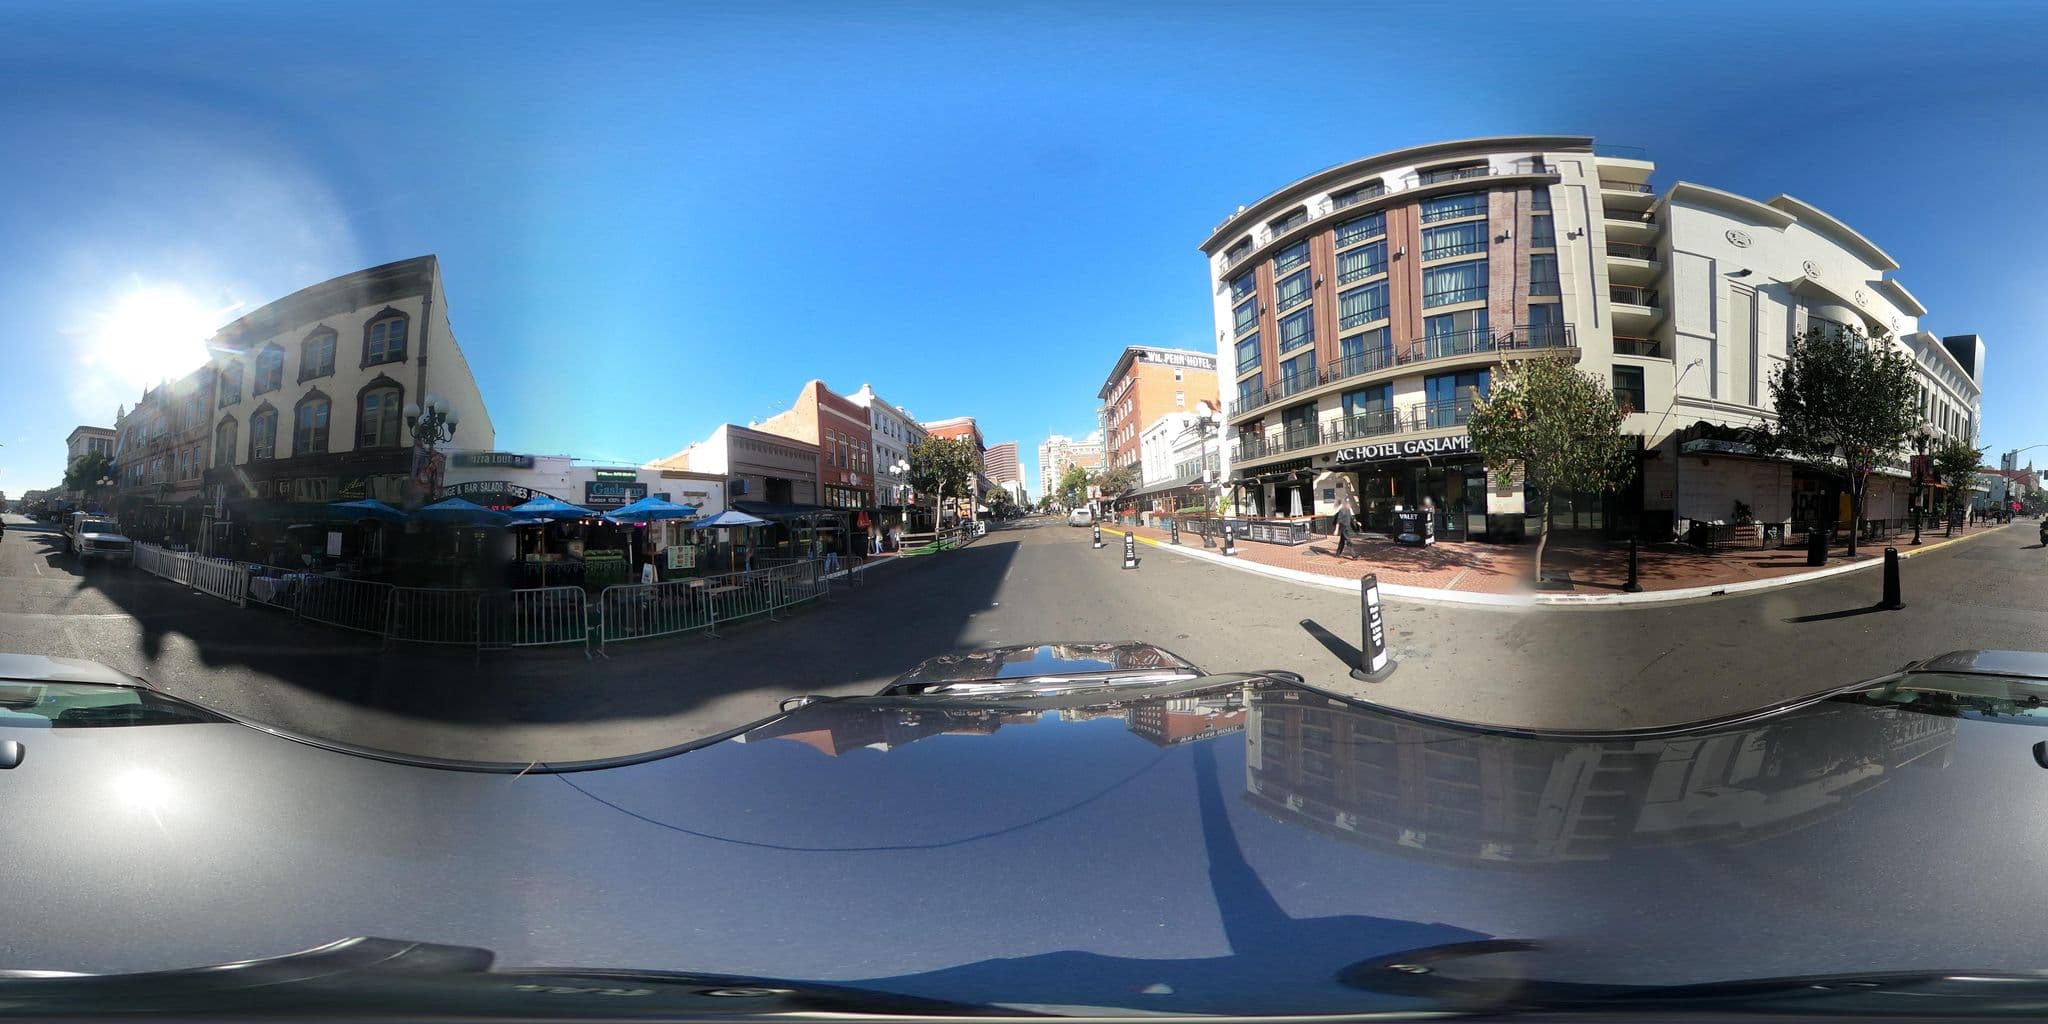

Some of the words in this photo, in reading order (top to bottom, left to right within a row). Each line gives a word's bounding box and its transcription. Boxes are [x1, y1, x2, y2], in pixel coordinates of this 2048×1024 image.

[1164, 353, 1185, 365] PENN
[1335, 449, 1354, 462] AC
[1356, 443, 1401, 459] HOTEL
[1404, 436, 1472, 453] GASLAMP
[464, 482, 479, 493] BAR
